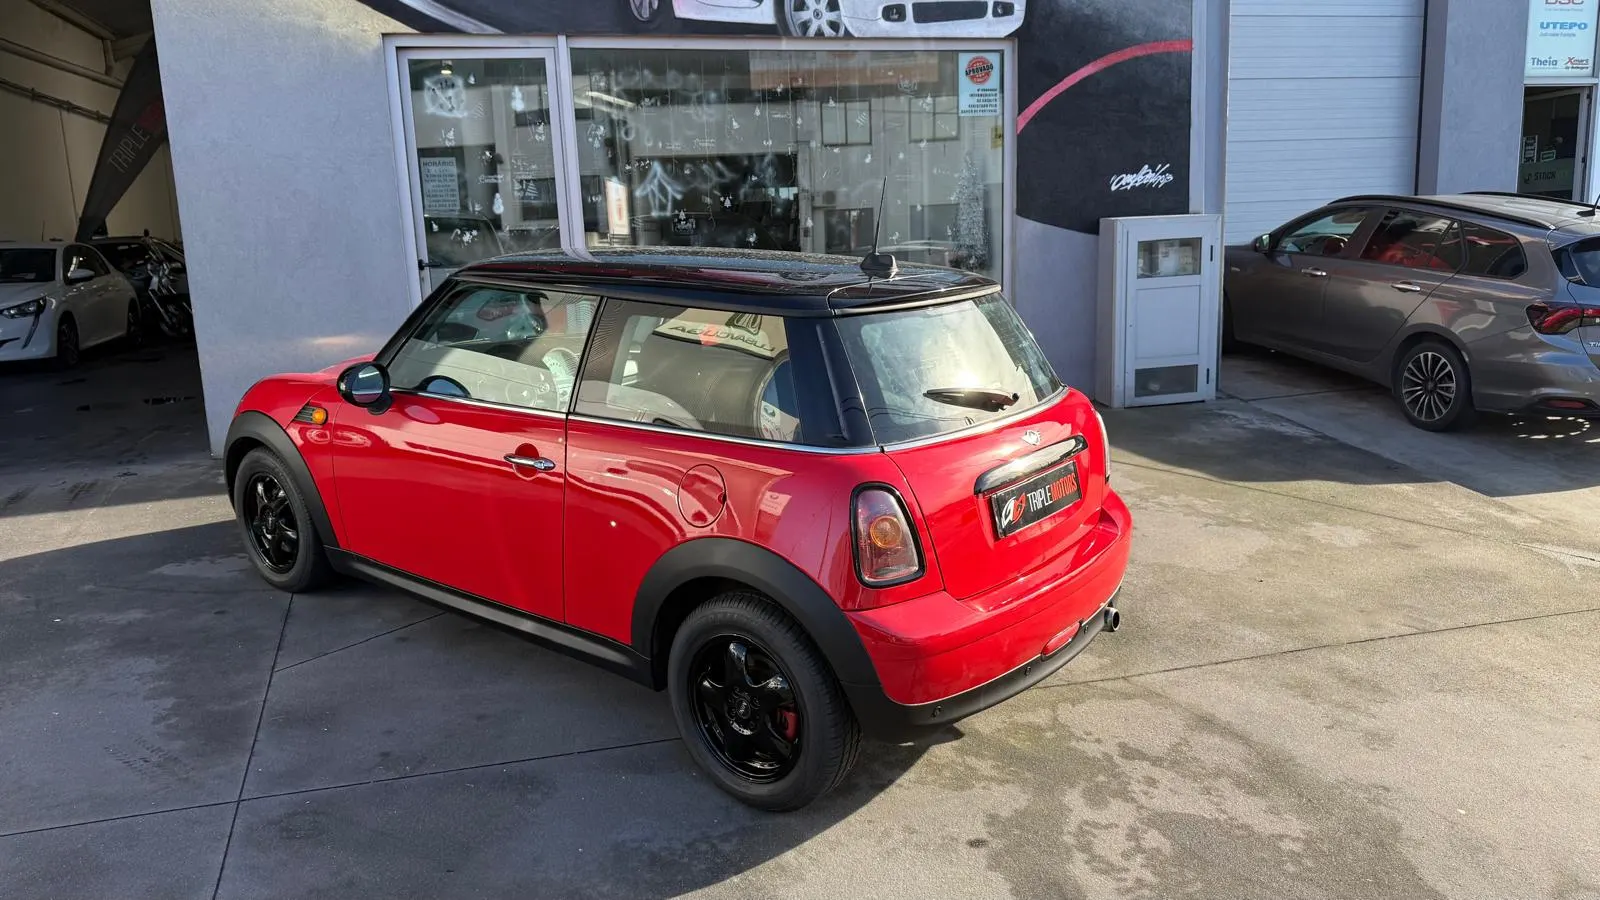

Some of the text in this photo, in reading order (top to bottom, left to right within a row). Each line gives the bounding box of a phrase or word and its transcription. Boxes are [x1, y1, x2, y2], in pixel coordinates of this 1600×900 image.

[1540, 22, 1588, 30] UTEPO
[1531, 56, 1558, 66] Theia
[965, 63, 994, 76] APROVADO
[107, 123, 150, 174] TRIPLE
[1027, 472, 1078, 513] TRIPLEMOTORS
